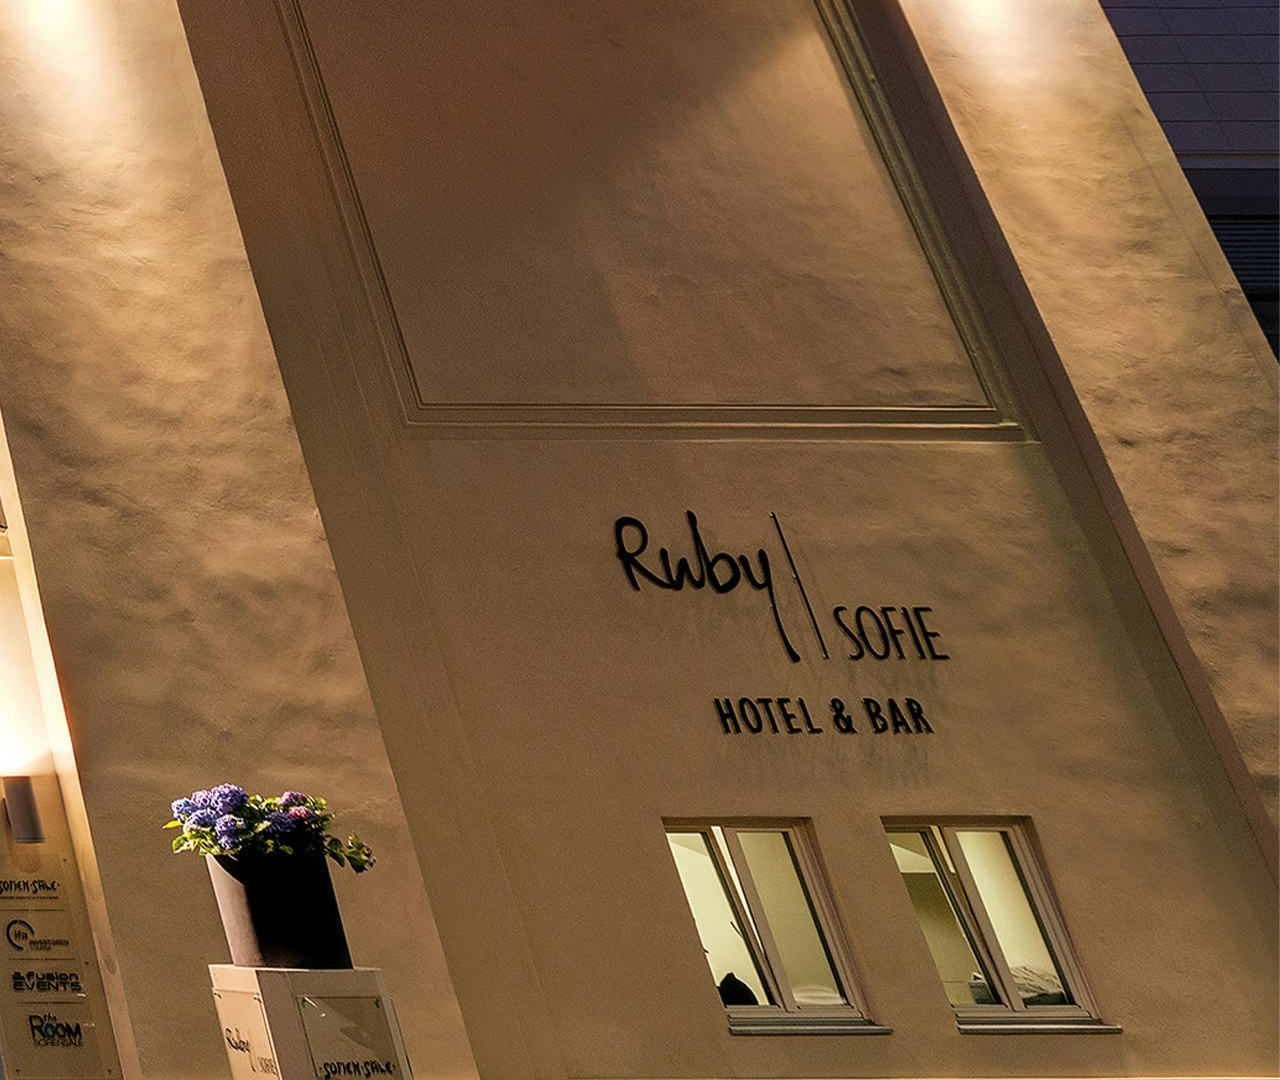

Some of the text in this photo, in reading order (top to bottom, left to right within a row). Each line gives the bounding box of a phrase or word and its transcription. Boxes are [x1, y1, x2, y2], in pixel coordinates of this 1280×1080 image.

[614, 510, 951, 663] Ruby SOFIE
[713, 697, 935, 735] HOTEL & BAR
[12, 981, 81, 991] EVENTS
